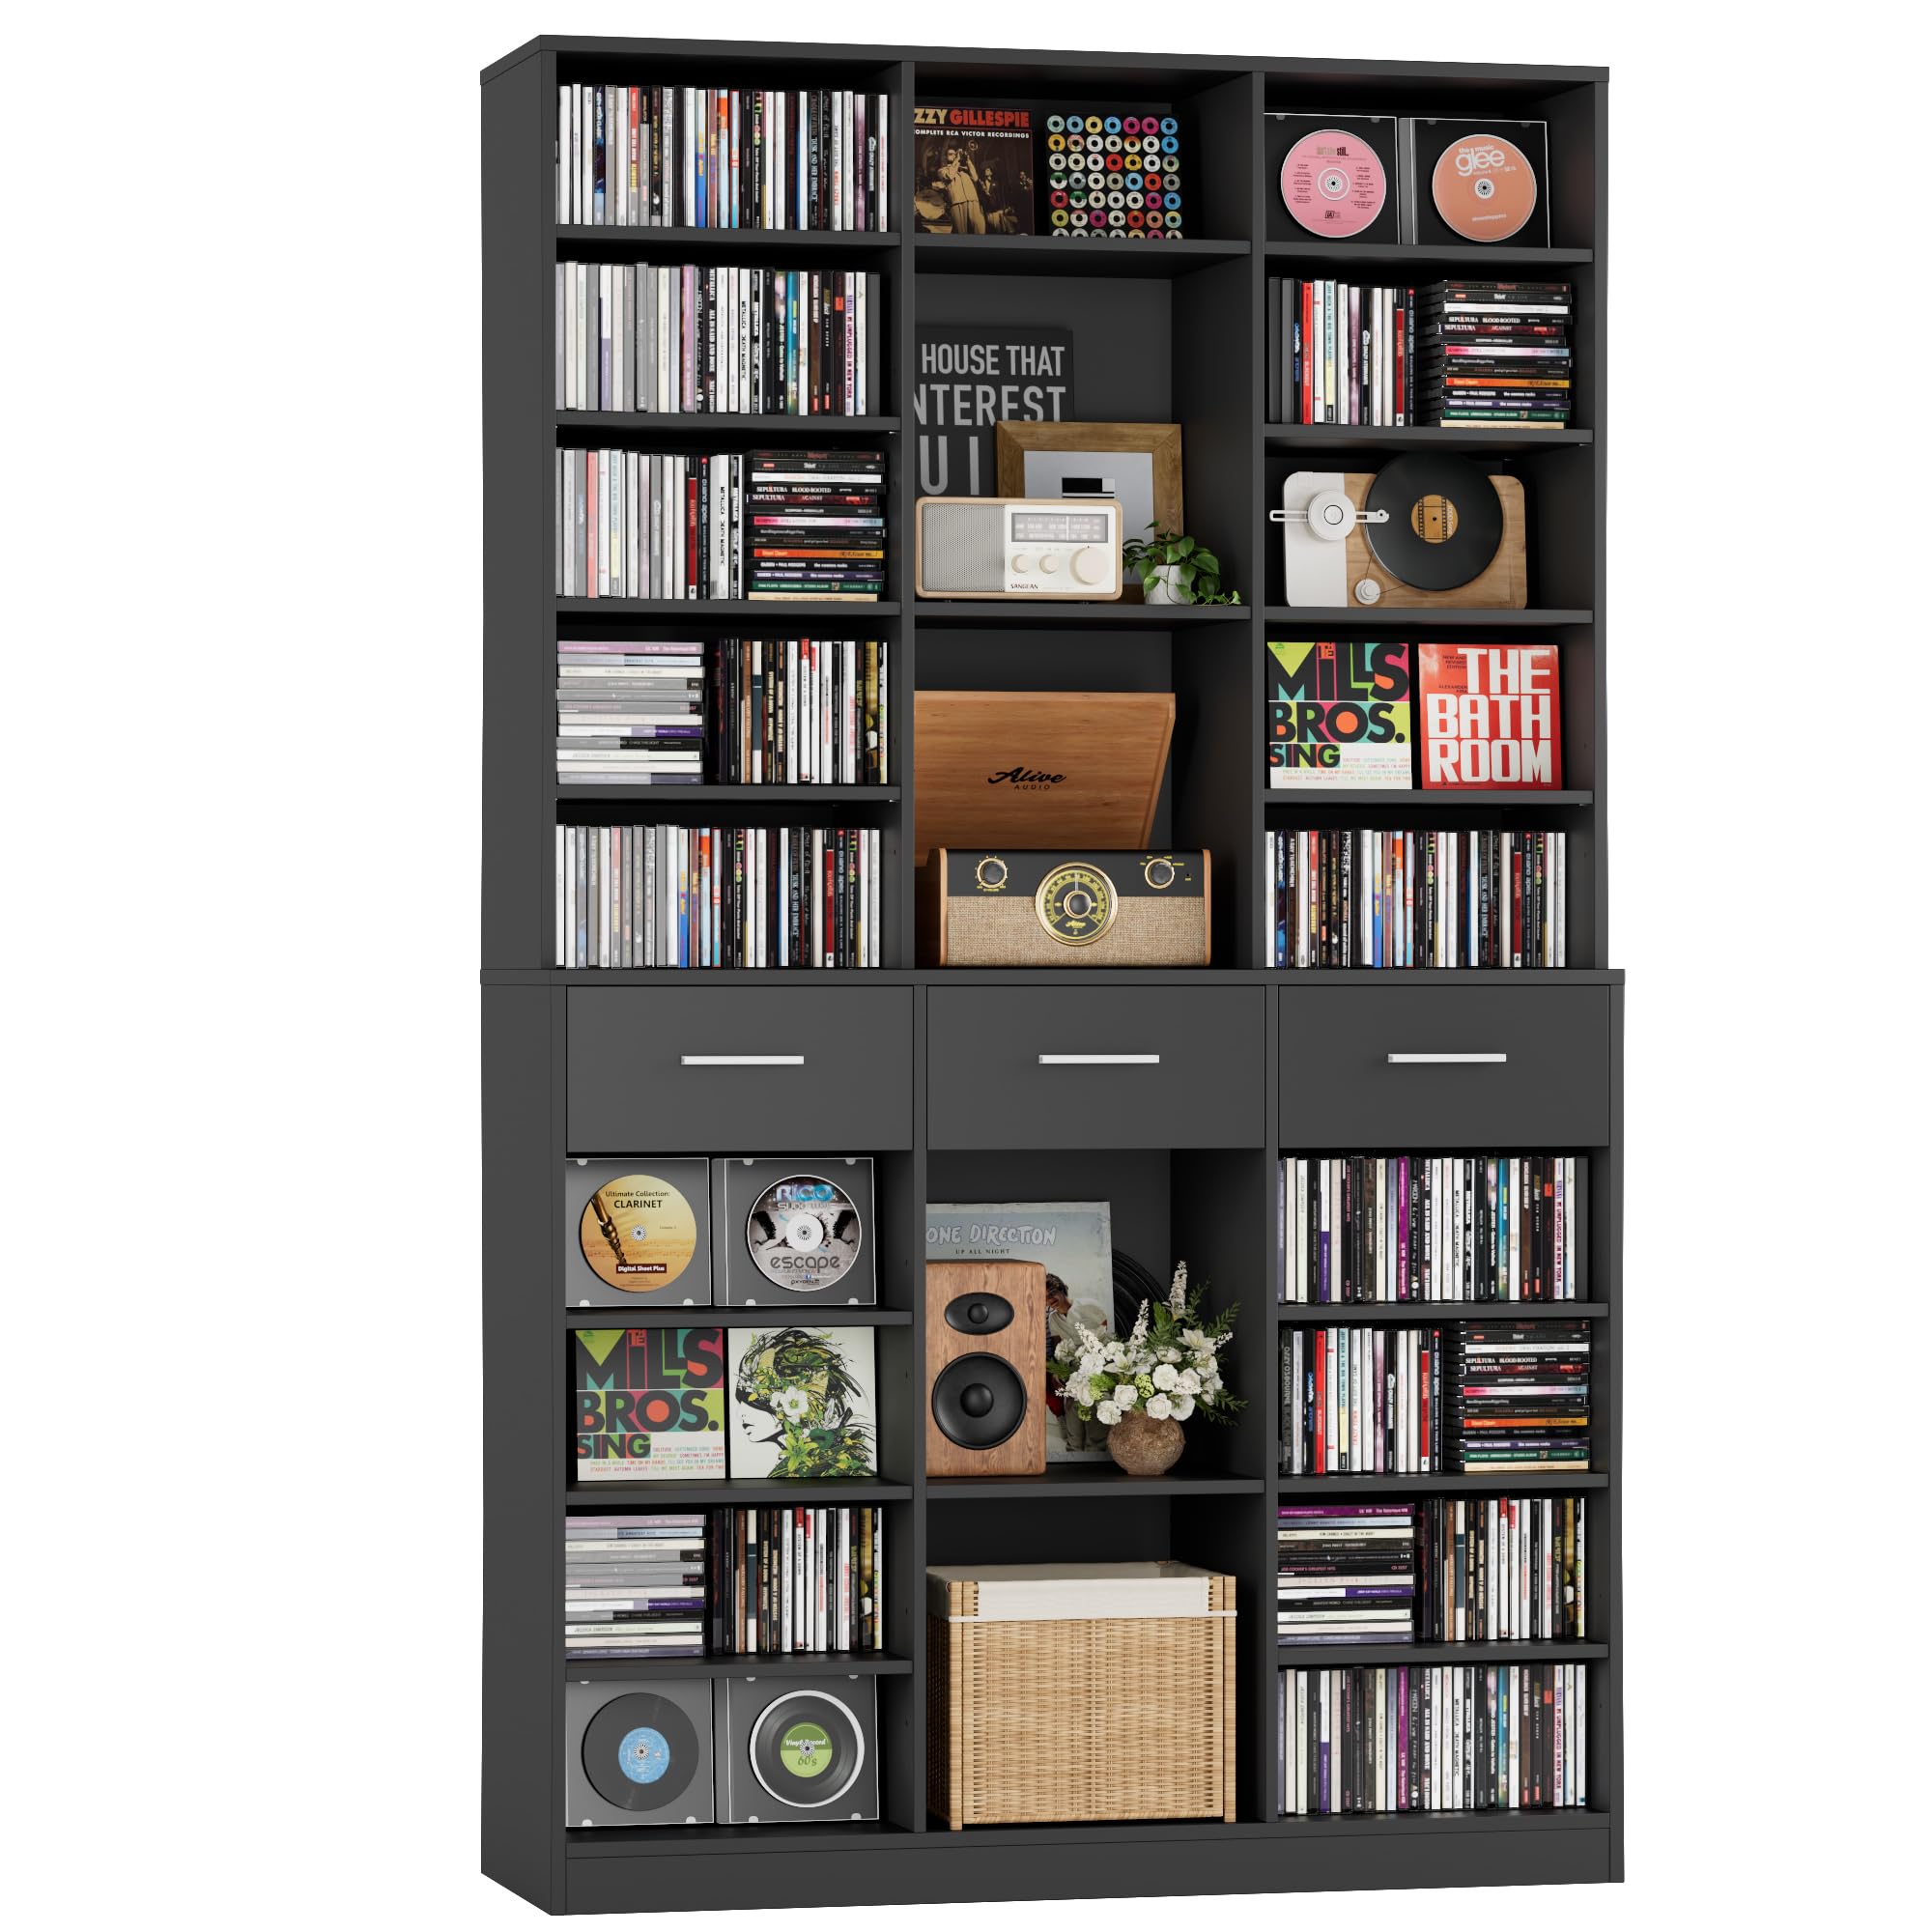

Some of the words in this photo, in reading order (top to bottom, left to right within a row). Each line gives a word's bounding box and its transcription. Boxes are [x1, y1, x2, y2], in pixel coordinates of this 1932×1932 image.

[914, 108, 948, 125] ZZY
[950, 109, 1030, 128] GILLESPIE
[1455, 150, 1505, 177] glee
[922, 344, 1000, 375] HOUSE
[1006, 346, 1065, 376] THAT
[1458, 648, 1550, 694] THE
[1269, 702, 1406, 743] BROS.
[1426, 694, 1550, 738] BATH
[1269, 744, 1340, 768] SING
[1428, 739, 1551, 782] ROOM
[987, 766, 1066, 784] Alive
[613, 1200, 664, 1208] CLARINET
[635, 1189, 670, 1198] Collection:
[926, 1226, 961, 1245] ONE
[969, 1224, 1057, 1246] DIRECTION
[770, 1256, 840, 1273] escape
[579, 1390, 719, 1434] BROS.
[578, 1434, 651, 1459] SING
